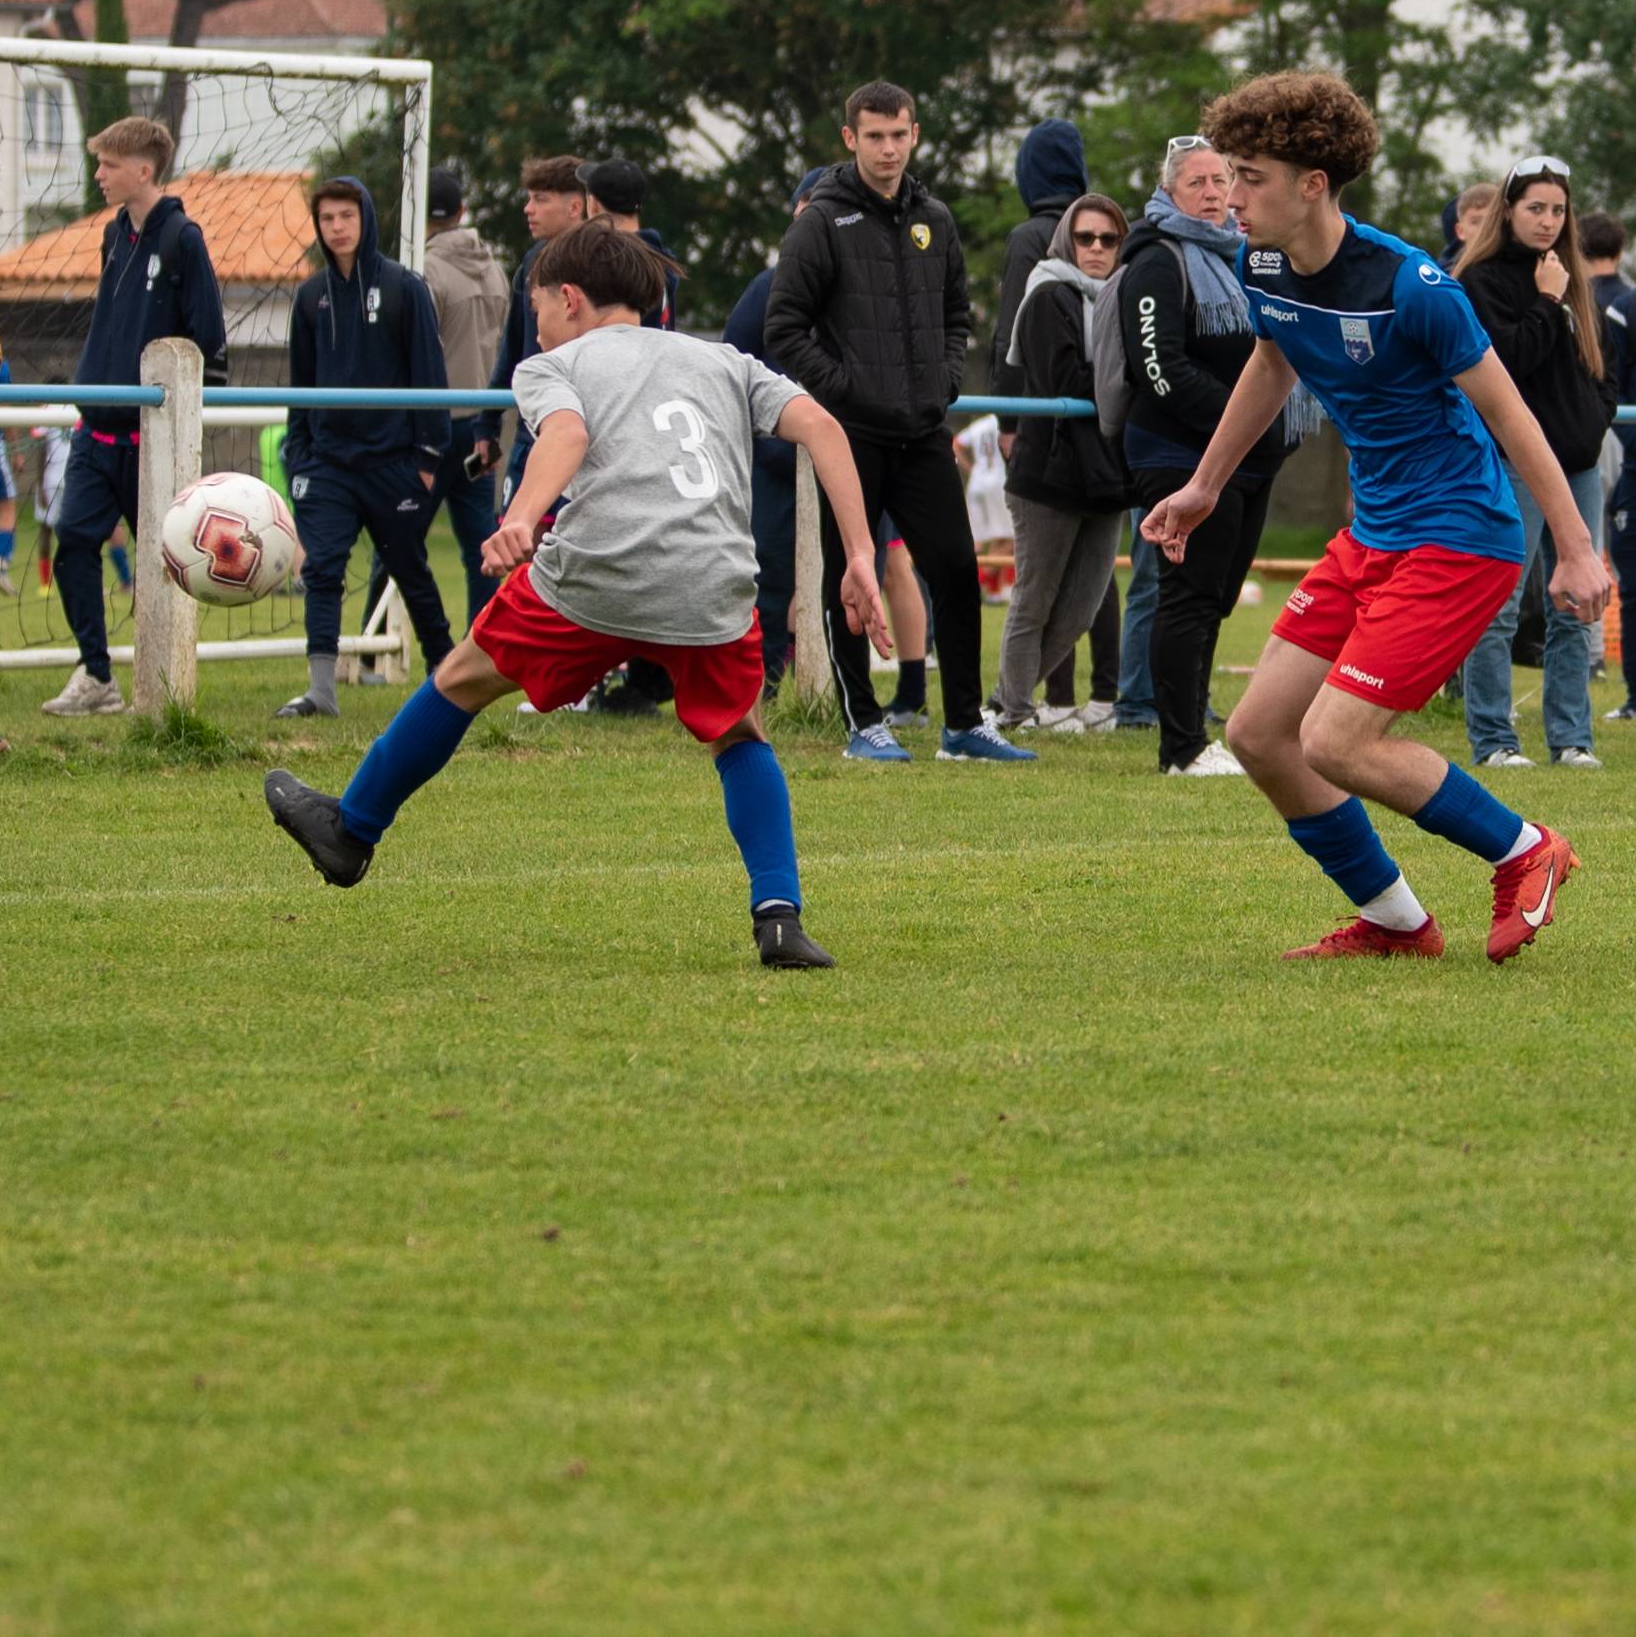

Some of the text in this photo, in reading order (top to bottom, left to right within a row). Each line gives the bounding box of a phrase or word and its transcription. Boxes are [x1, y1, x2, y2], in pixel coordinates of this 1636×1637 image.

[1261, 305, 1299, 322] uhlsport
[1138, 296, 1172, 396] SOLANO
[652, 400, 719, 499] 3
[1340, 664, 1384, 689] uhlsport
